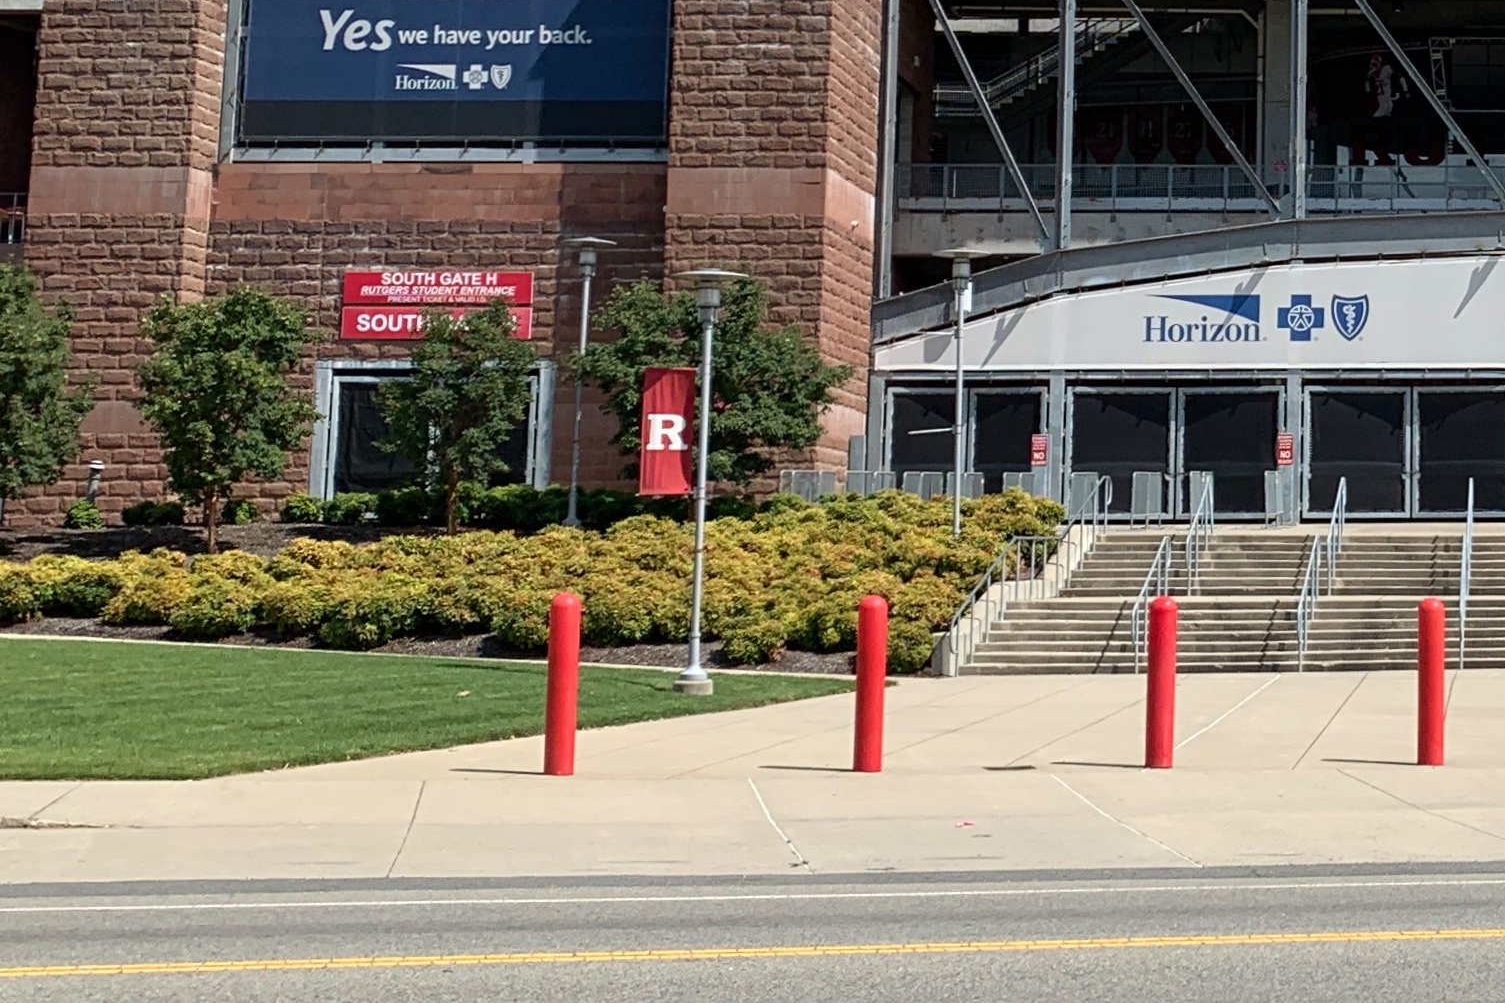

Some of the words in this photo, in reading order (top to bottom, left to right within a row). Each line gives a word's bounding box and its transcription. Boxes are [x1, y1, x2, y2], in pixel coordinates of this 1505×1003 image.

[319, 9, 395, 51] Yes
[398, 29, 428, 44] we
[434, 25, 481, 44] have
[485, 28, 535, 49] your
[539, 25, 592, 44] back.
[395, 74, 457, 90] Horizon
[381, 272, 435, 285] SOUTH
[440, 272, 482, 285] GATE
[486, 273, 497, 285] H
[361, 286, 410, 295] RUTGERS
[412, 286, 458, 295] STUDENT
[459, 286, 516, 295] ENTRANCE
[1142, 315, 1261, 343] Horizon
[646, 413, 688, 451] R
[1034, 452, 1044, 460] NO
[1280, 451, 1291, 459] NO
